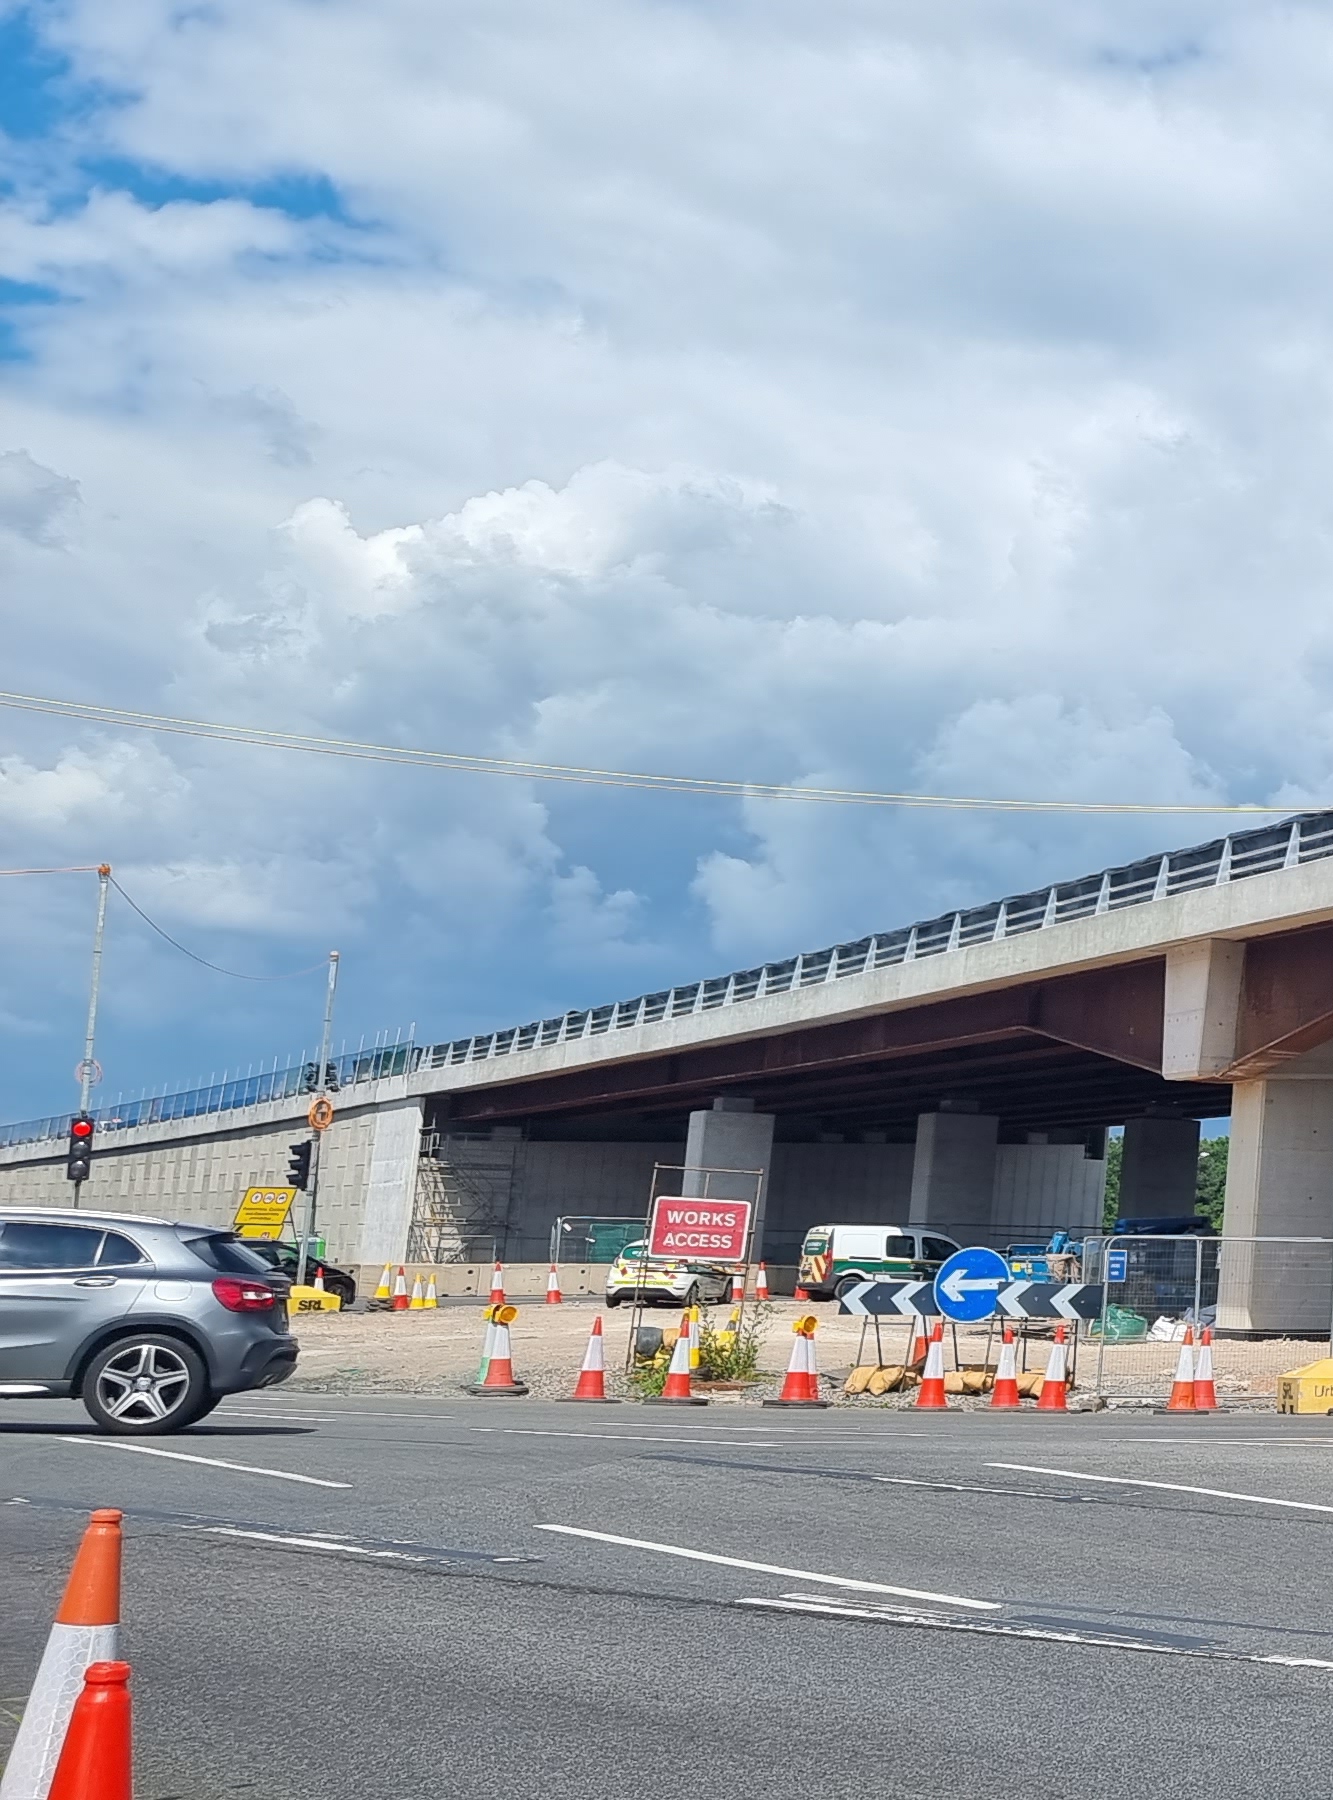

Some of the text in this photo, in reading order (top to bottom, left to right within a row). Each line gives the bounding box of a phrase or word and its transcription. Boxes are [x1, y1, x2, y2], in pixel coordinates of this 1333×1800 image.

[667, 1210, 736, 1227] WORKS
[662, 1232, 733, 1249] ACCESS
[297, 1299, 325, 1311] SRL
